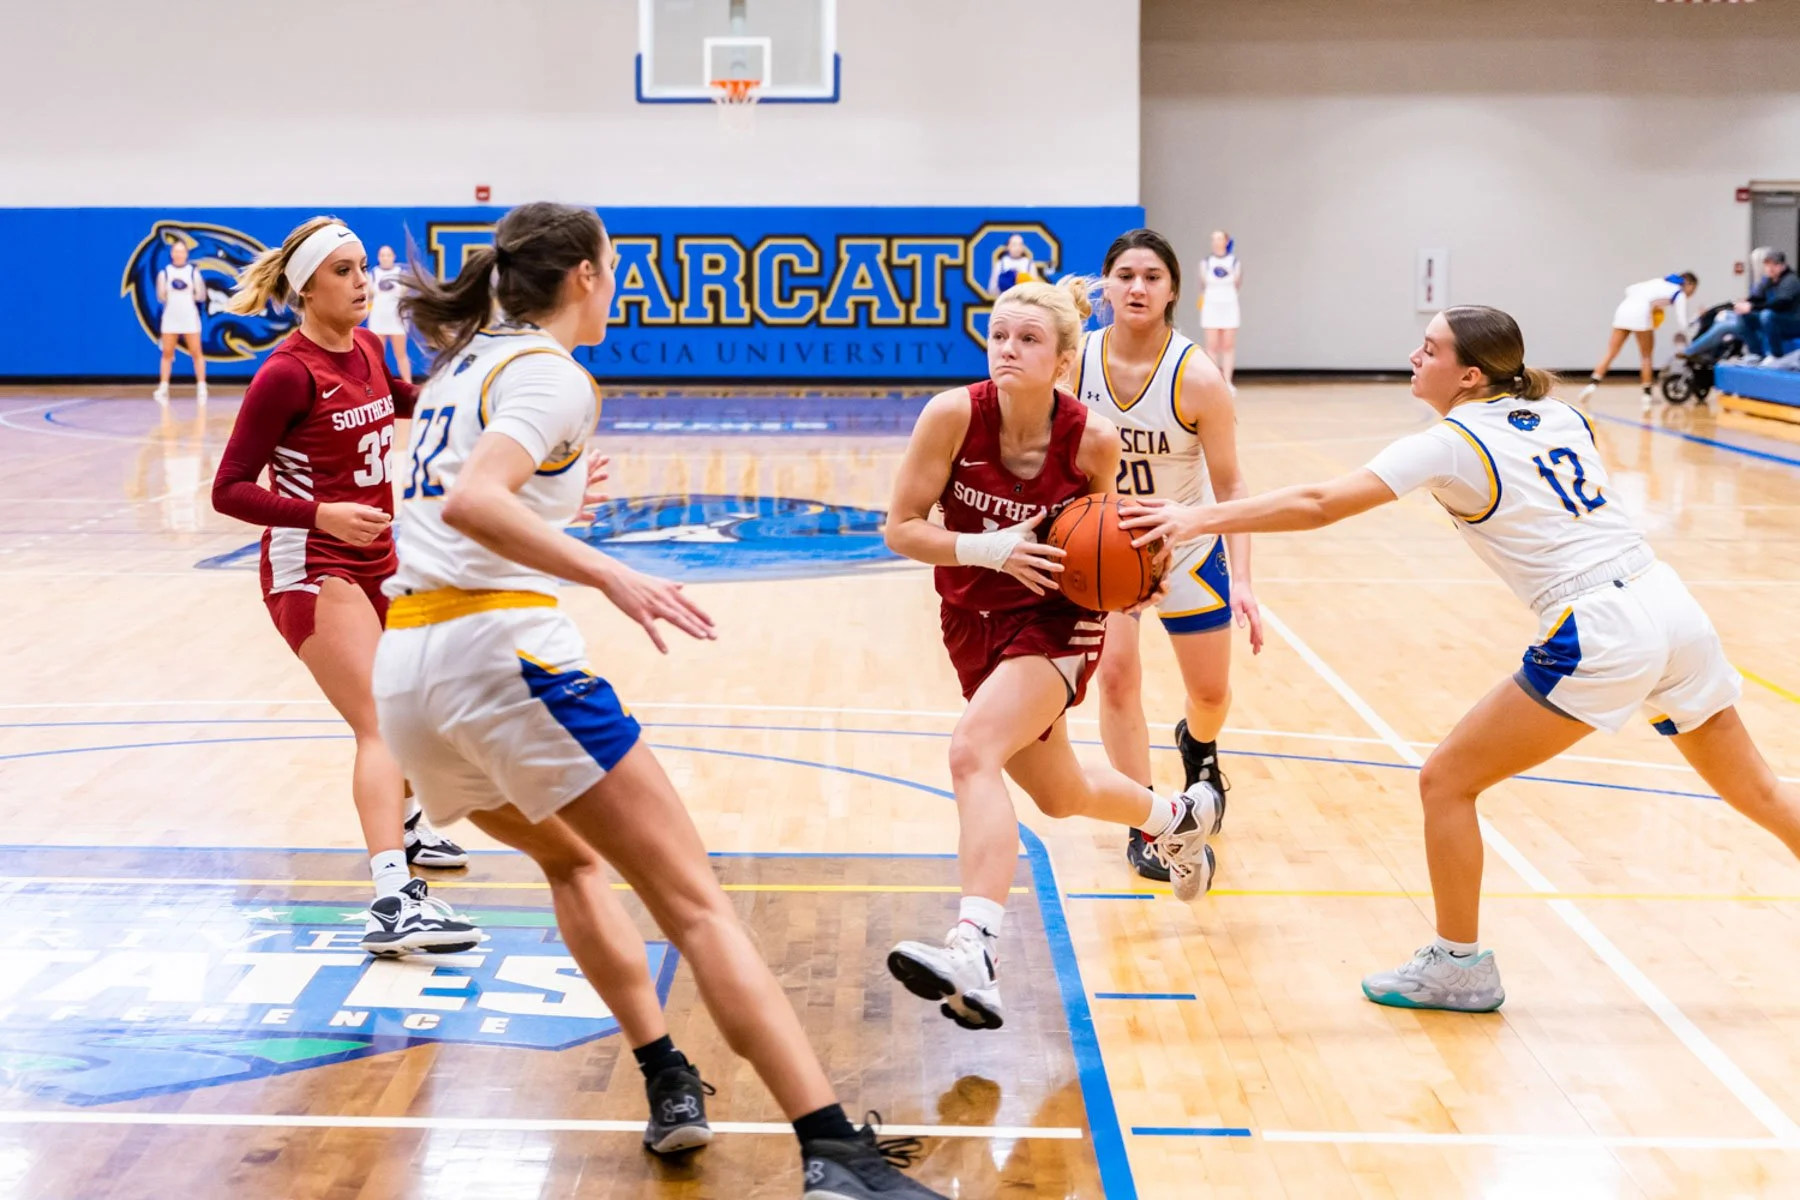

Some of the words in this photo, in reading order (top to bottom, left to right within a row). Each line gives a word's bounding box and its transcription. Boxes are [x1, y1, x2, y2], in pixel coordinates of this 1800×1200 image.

[427, 222, 1061, 352] ARCATS
[587, 342, 695, 364] ESCIA
[716, 342, 954, 364] UNIVERSITY
[332, 394, 395, 432] SOUTHEAS
[1116, 426, 1171, 455] SCIA
[1116, 459, 1155, 496] 20
[1531, 446, 1607, 519] 12
[5, 928, 493, 953] RIVE
[0, 950, 615, 1019] TATES
[0, 1005, 511, 1035] FERENCE
